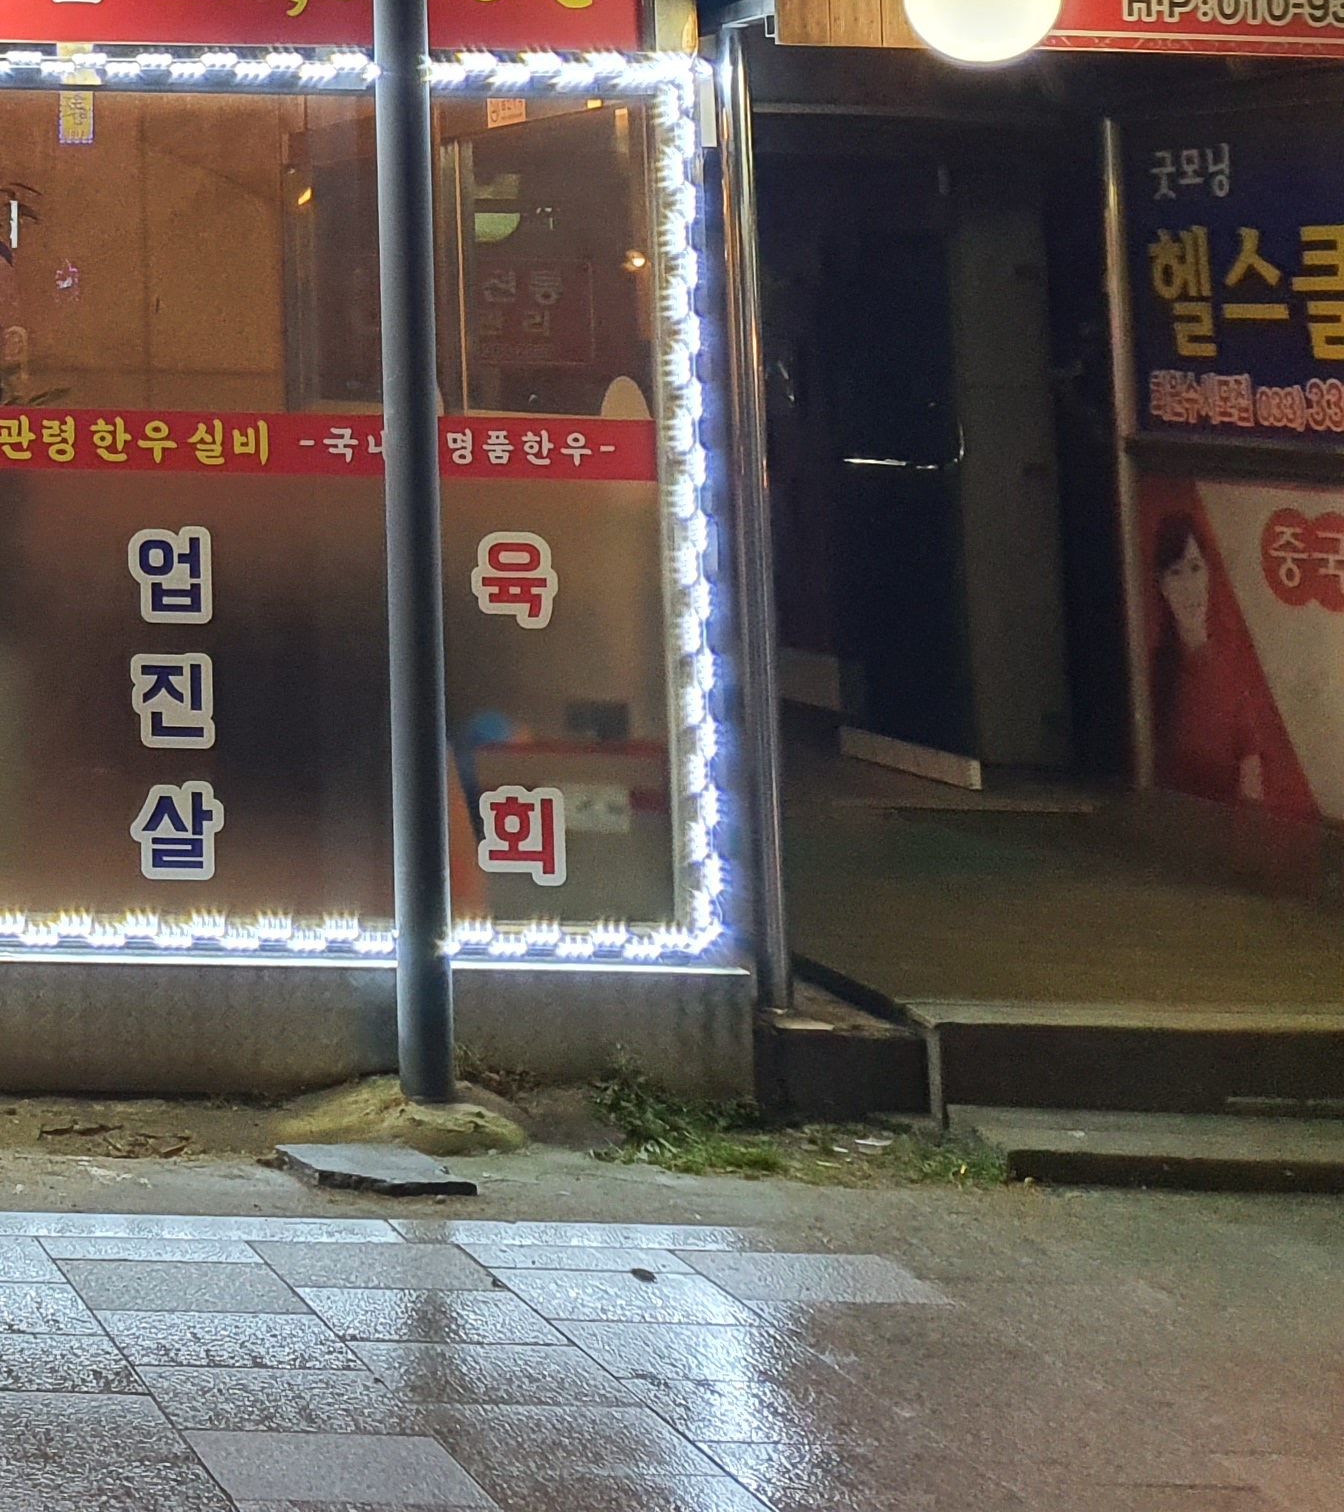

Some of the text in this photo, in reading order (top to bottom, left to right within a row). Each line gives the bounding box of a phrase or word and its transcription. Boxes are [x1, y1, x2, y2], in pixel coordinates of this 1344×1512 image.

[1149, 142, 1230, 200] 굿모닝
[89, 415, 178, 466] 한우
[186, 417, 270, 467] 실비
[299, 427, 617, 468] -국명품한우-
[138, 535, 214, 870] 업진살
